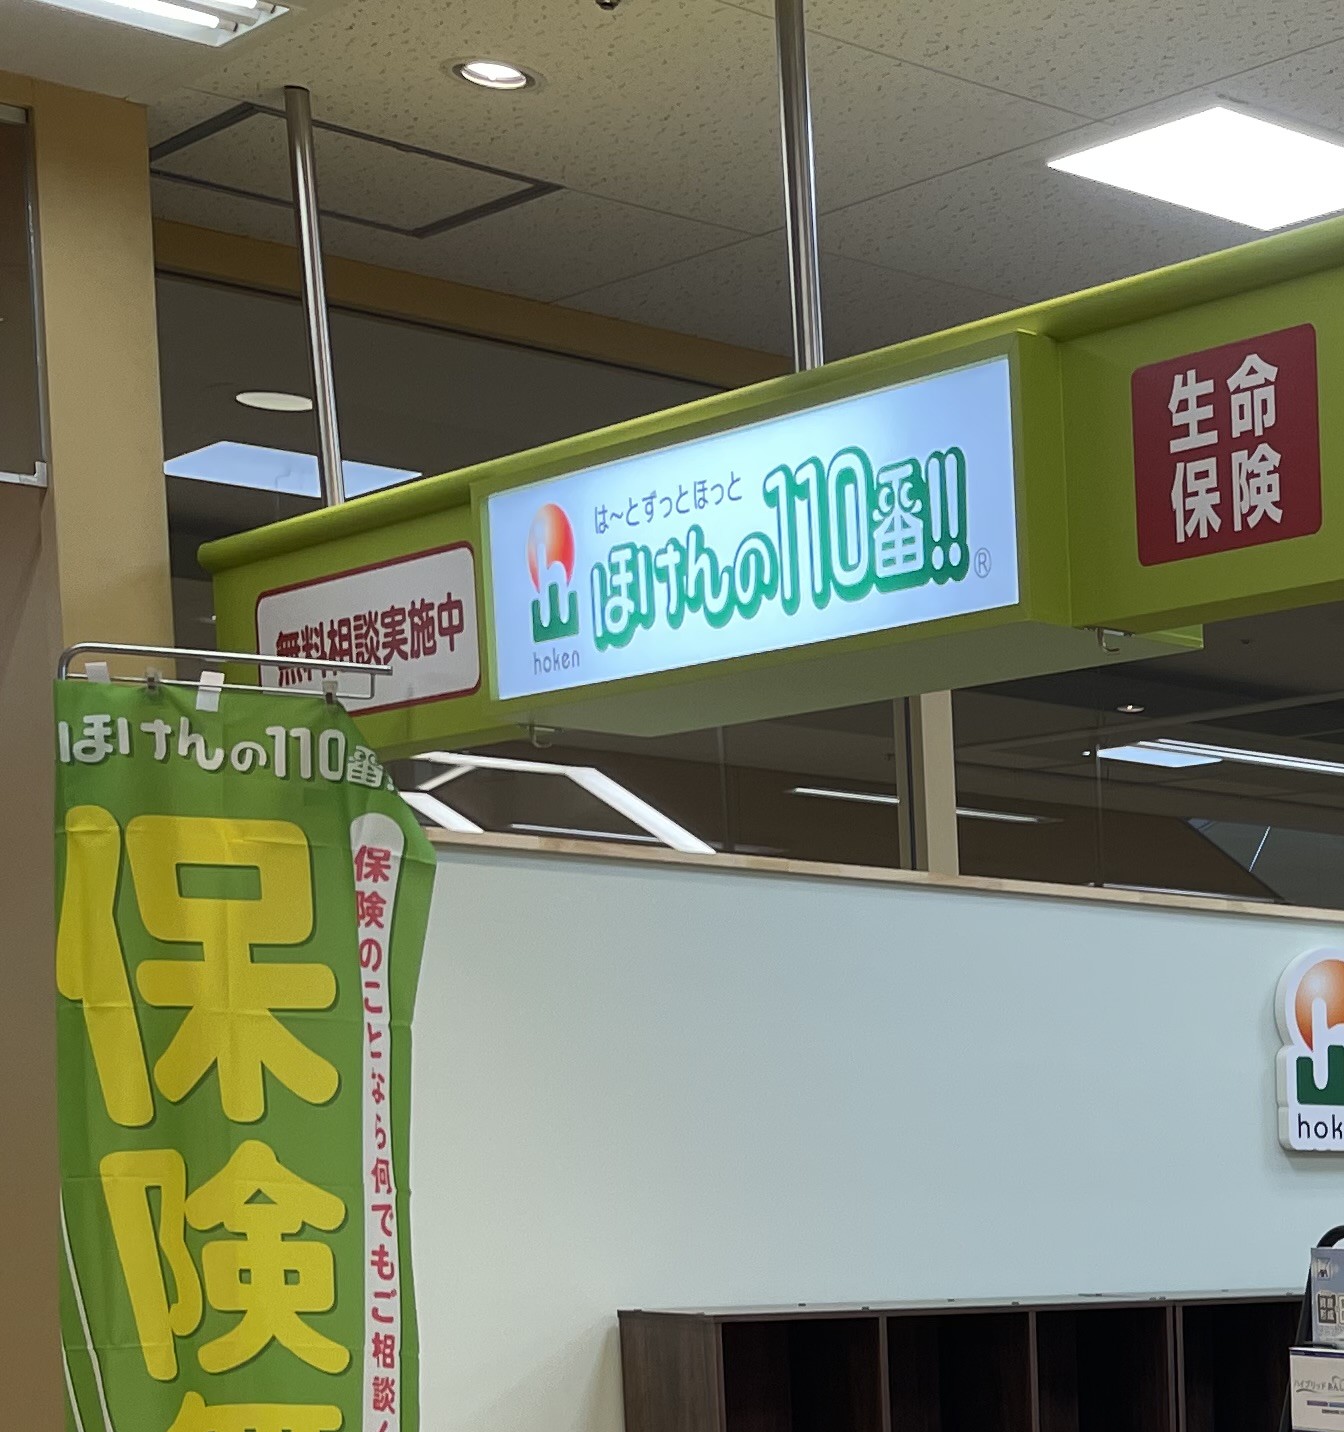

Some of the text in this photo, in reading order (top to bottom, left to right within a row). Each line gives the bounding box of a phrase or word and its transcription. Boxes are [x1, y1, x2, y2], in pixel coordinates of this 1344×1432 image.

[1167, 354, 1279, 453] 生命
[1172, 444, 1283, 544] 保険
[274, 593, 466, 687] 無料相談実施中
[532, 649, 580, 675] hoken
[58, 714, 398, 791] ほけんの110番
